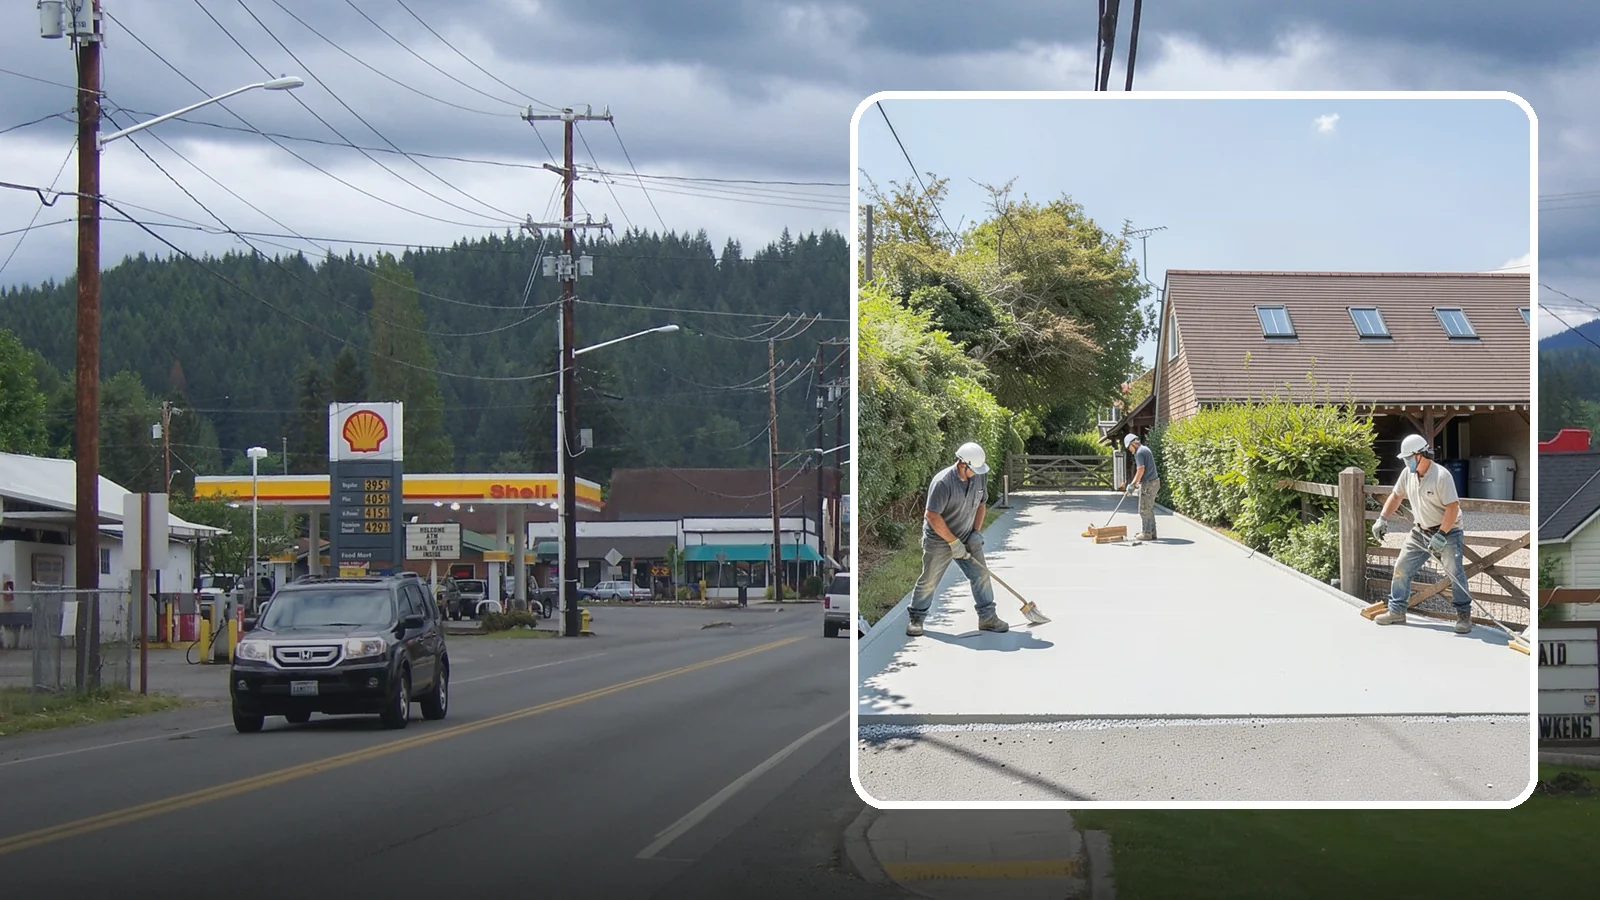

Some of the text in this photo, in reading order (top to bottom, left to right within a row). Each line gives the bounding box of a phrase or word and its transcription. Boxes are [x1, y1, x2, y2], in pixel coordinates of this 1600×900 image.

[366, 480, 383, 490] 395
[490, 484, 547, 499] Shell
[366, 494, 383, 504] 405
[366, 507, 383, 518] 415
[366, 522, 383, 533] 429
